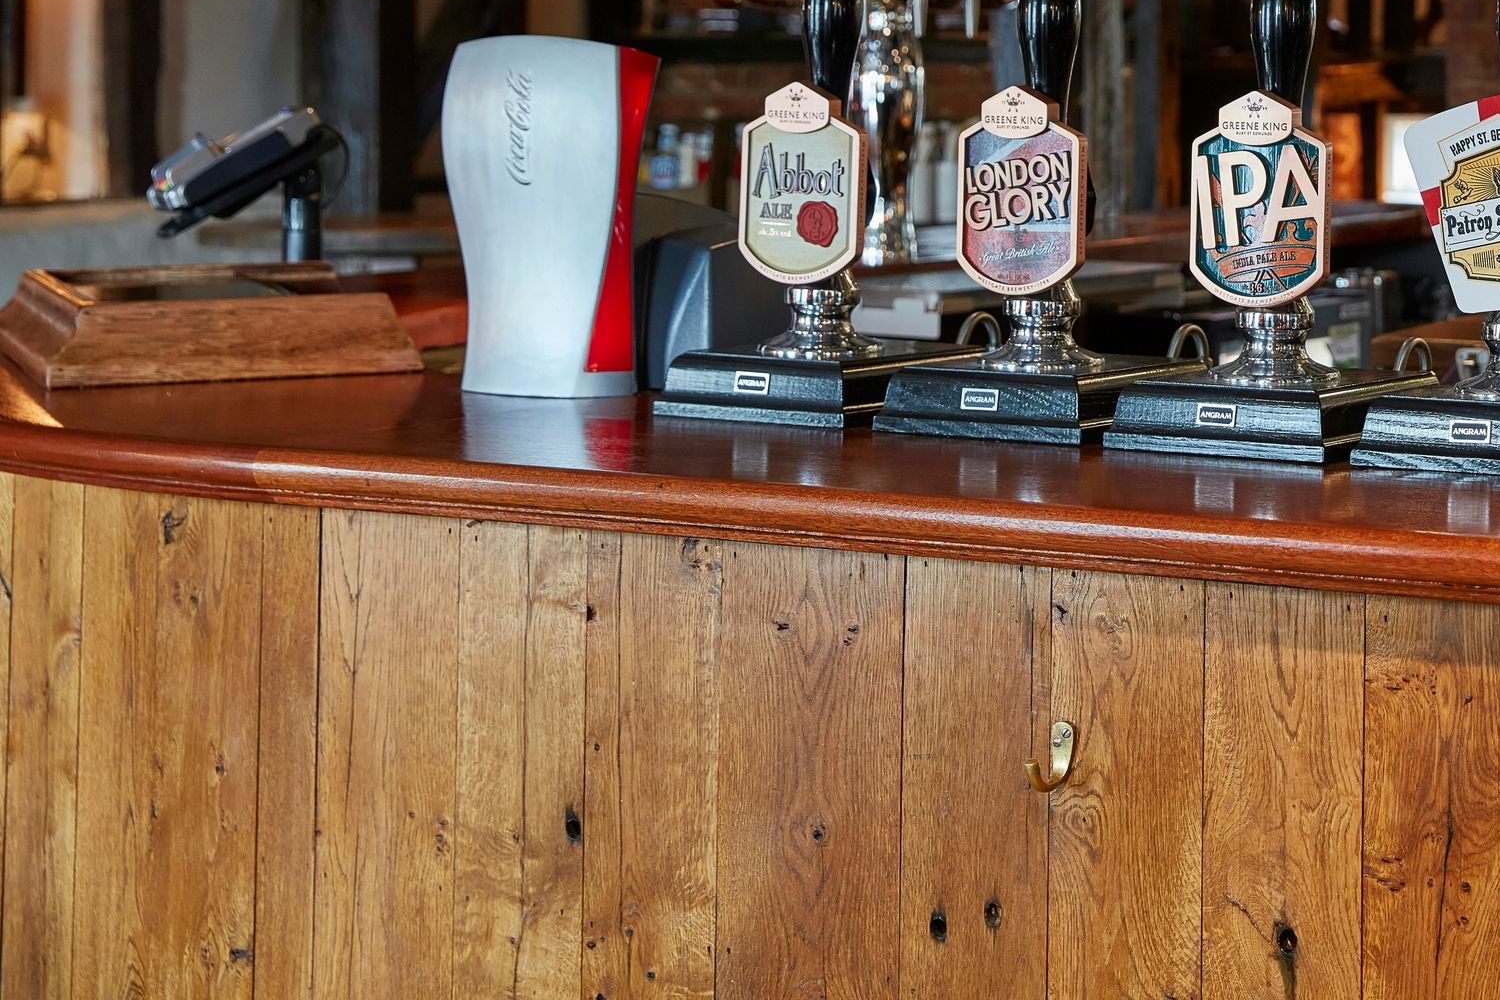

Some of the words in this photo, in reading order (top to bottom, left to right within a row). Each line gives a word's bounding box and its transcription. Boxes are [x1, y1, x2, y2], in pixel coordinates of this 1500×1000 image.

[768, 109, 800, 119] GREENE
[803, 112, 825, 120] KING
[985, 115, 1018, 124] GREENE
[1021, 116, 1043, 125] KING
[1222, 121, 1259, 130] GREENE
[1262, 122, 1288, 131] KING
[1450, 135, 1476, 156] HAPPY
[1477, 132, 1490, 145] ST.
[752, 142, 845, 199] Abbot
[966, 151, 1071, 194] LONDON
[1198, 144, 1322, 249] IPA
[760, 202, 793, 220] ALE
[965, 182, 1070, 231] GLORY
[1446, 214, 1492, 237] Patron
[1005, 243, 1035, 260] British
[1233, 256, 1254, 269] INDIA
[1256, 254, 1277, 264] PALE
[1280, 250, 1296, 261] ALE
[738, 379, 766, 388] ANGRAM
[965, 396, 995, 404] ANGRAM
[1200, 410, 1232, 420] ANGRAM
[1452, 426, 1487, 436] ANGRAM
